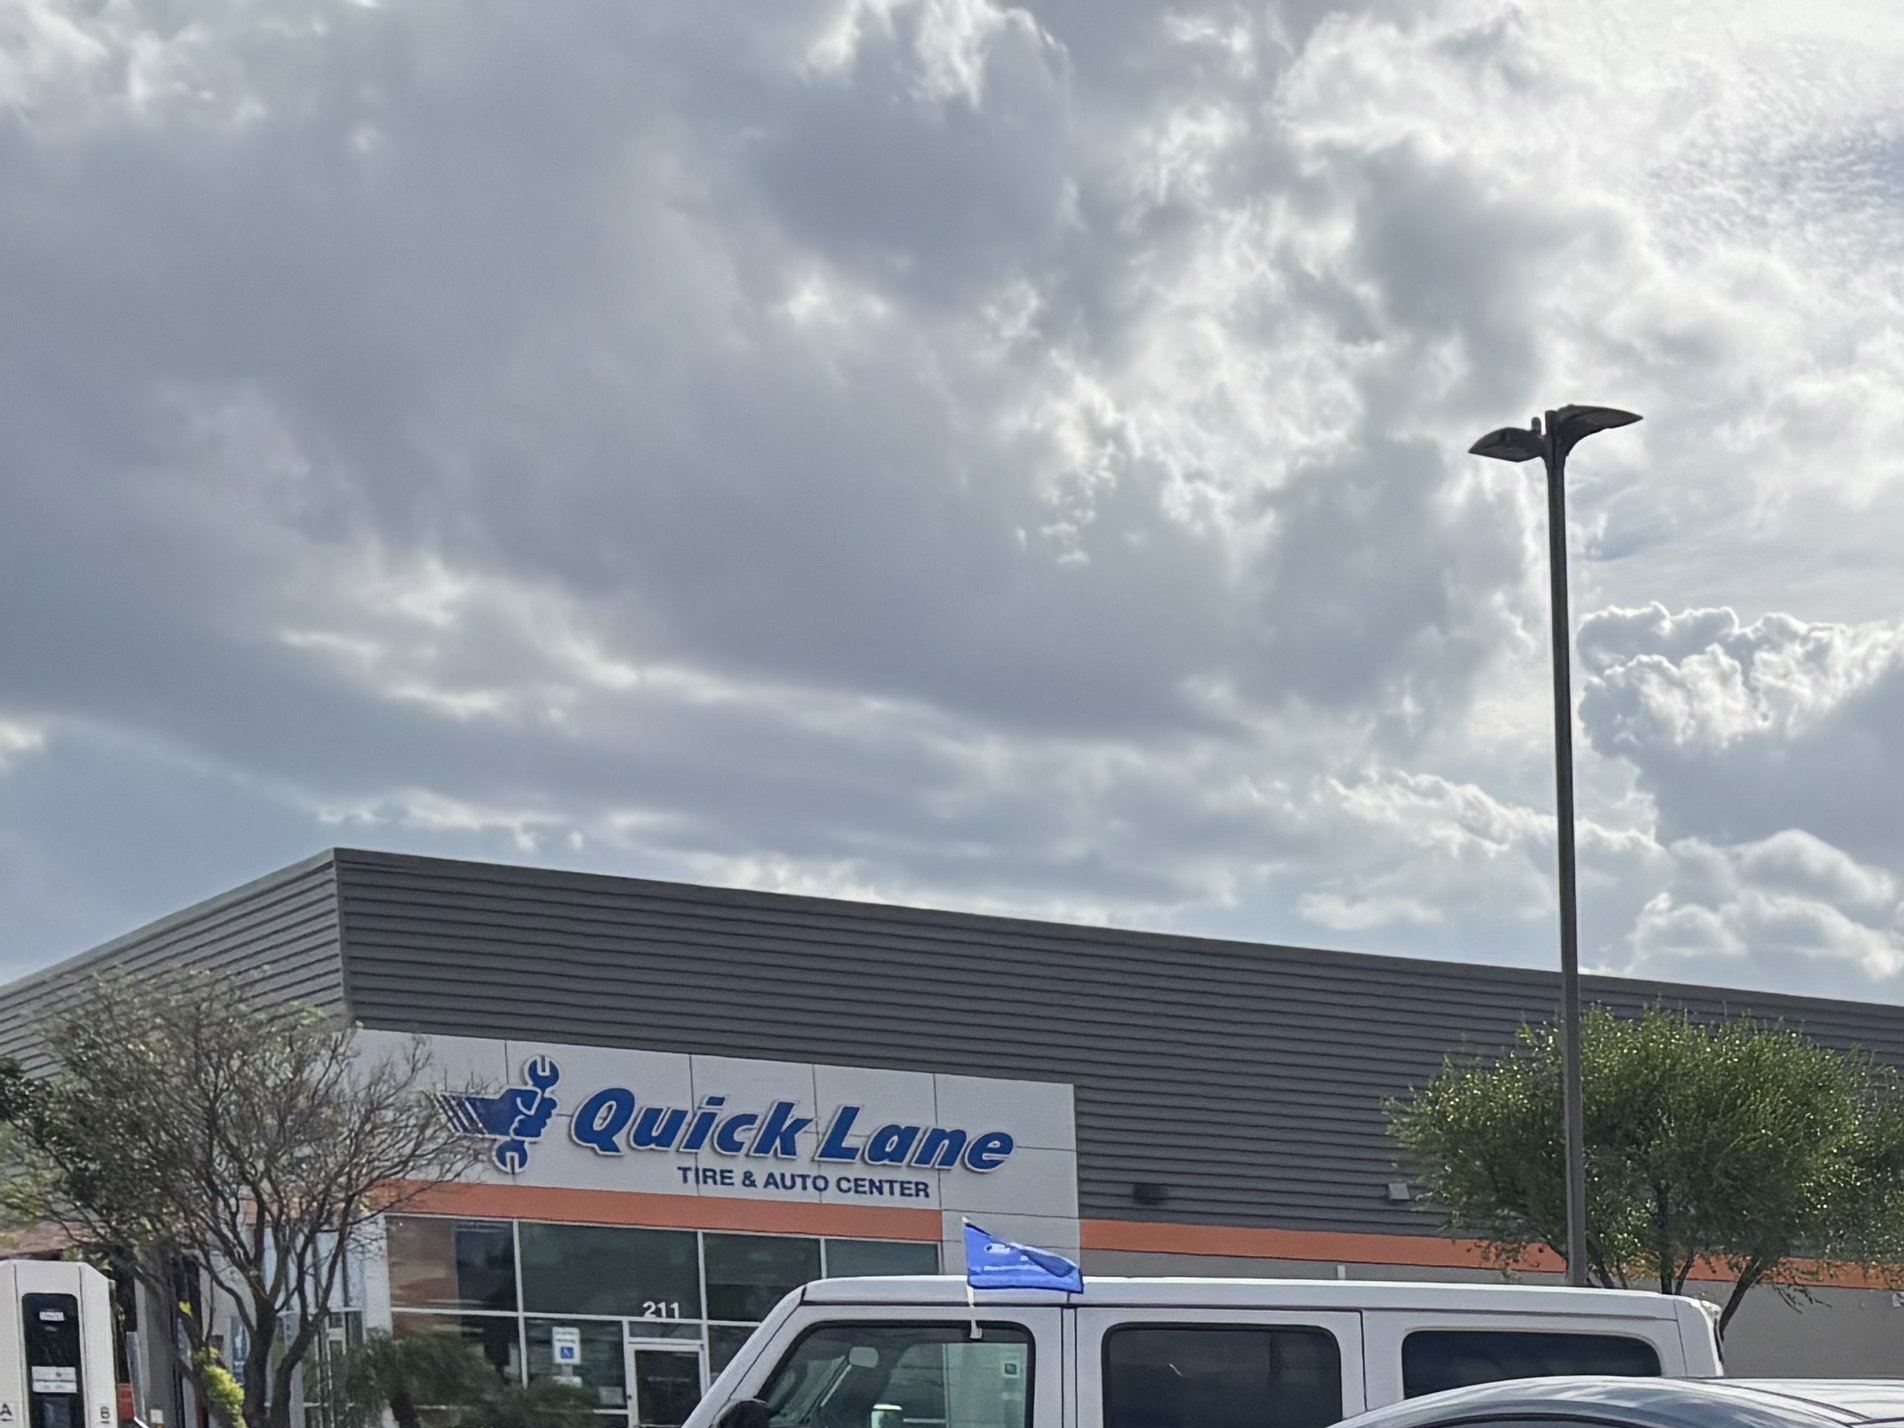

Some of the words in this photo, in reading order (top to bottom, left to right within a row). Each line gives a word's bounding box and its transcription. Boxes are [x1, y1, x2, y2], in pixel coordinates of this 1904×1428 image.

[572, 1087, 817, 1157] Quick
[815, 1104, 1015, 1173] Lane
[677, 1166, 735, 1187] TIRE
[742, 1170, 758, 1189] &
[763, 1171, 830, 1191] AUTO
[835, 1175, 931, 1199] CENTER
[642, 1301, 680, 1318] 211
